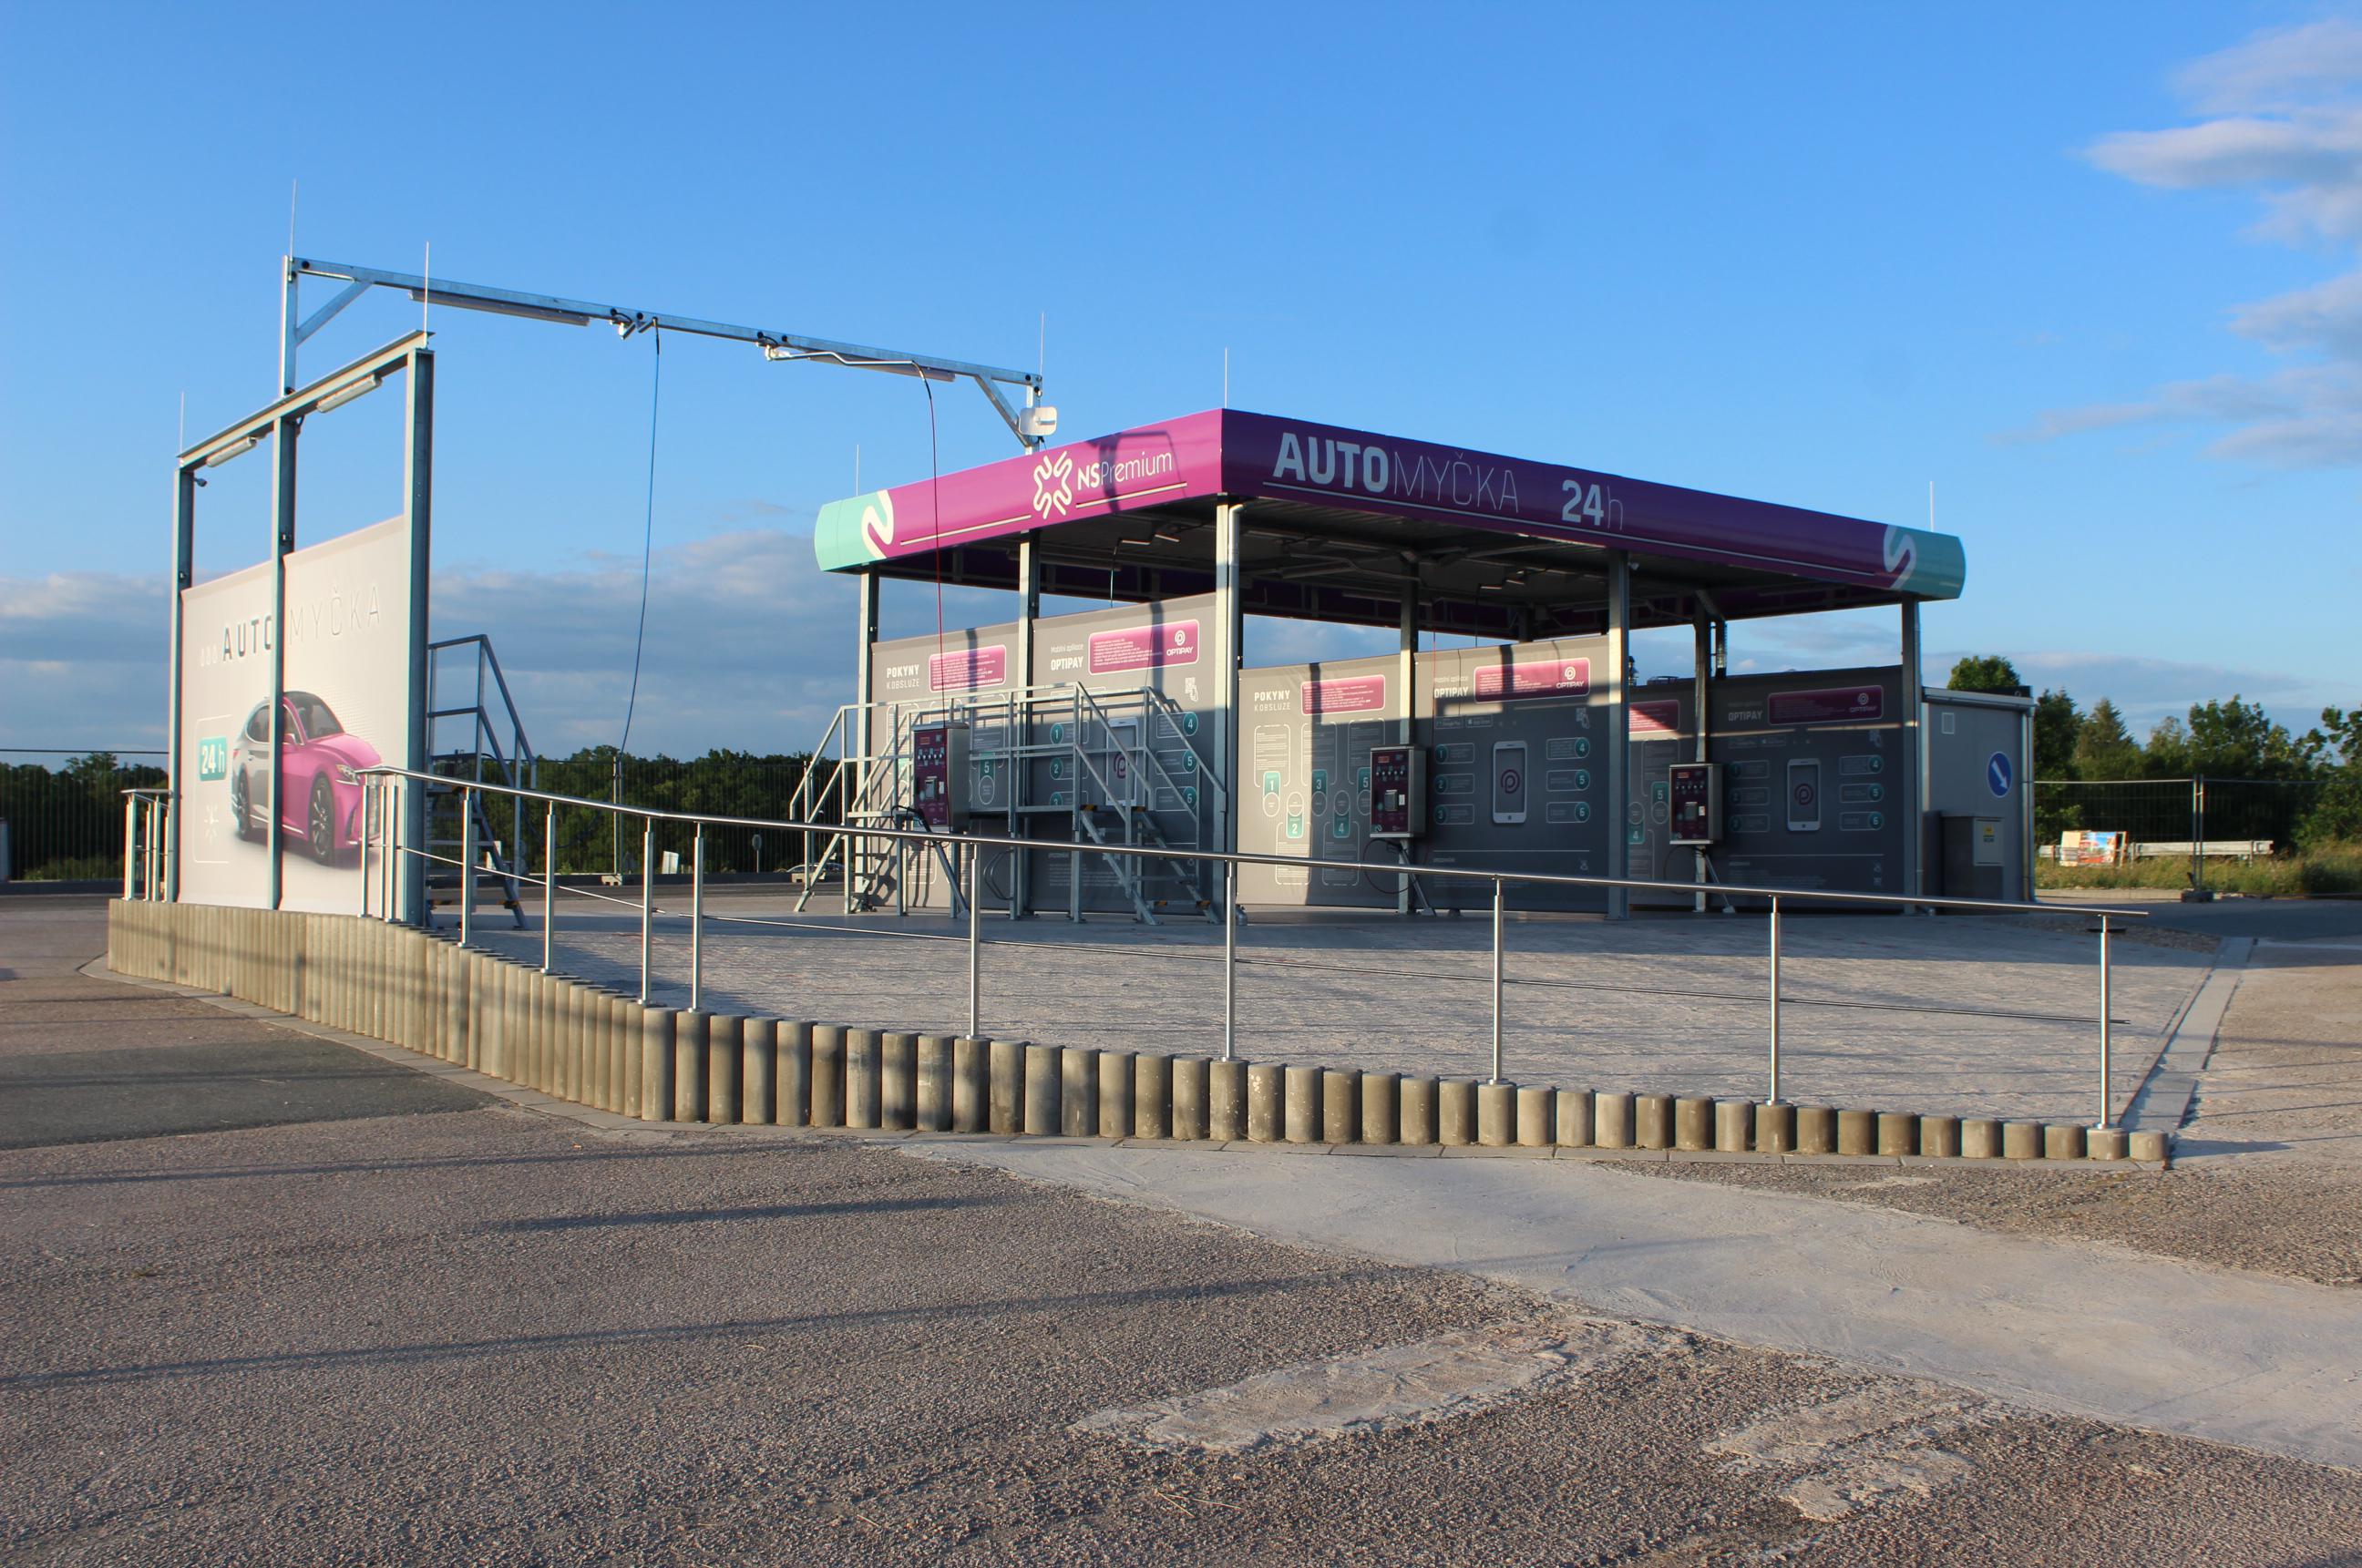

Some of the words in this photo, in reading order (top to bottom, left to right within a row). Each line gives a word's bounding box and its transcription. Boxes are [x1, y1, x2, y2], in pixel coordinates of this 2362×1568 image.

[1561, 478, 1624, 530] 24h
[1166, 646, 1194, 656] OPTIPAY
[1051, 656, 1083, 671] OPTIPAY
[887, 664, 919, 678] POKYNY
[1254, 690, 1290, 702] POKYNY
[1434, 686, 1469, 699] OPTIPAY
[1728, 711, 1763, 722] OPTIPAY
[1187, 718, 1193, 729] 4
[1579, 743, 1585, 752] 4
[1187, 755, 1193, 766] 5
[983, 761, 990, 773] 5
[1053, 764, 1059, 774] 2
[1316, 779, 1321, 789] 3
[1363, 777, 1369, 787] 5
[1579, 774, 1585, 784] 5
[1269, 779, 1274, 791] 1
[1186, 794, 1192, 803] 6
[1657, 790, 1663, 801] 5
[1579, 807, 1585, 816] 6
[1292, 823, 1298, 834] 2
[1339, 823, 1344, 834] 4
[1633, 830, 1638, 840] 4
